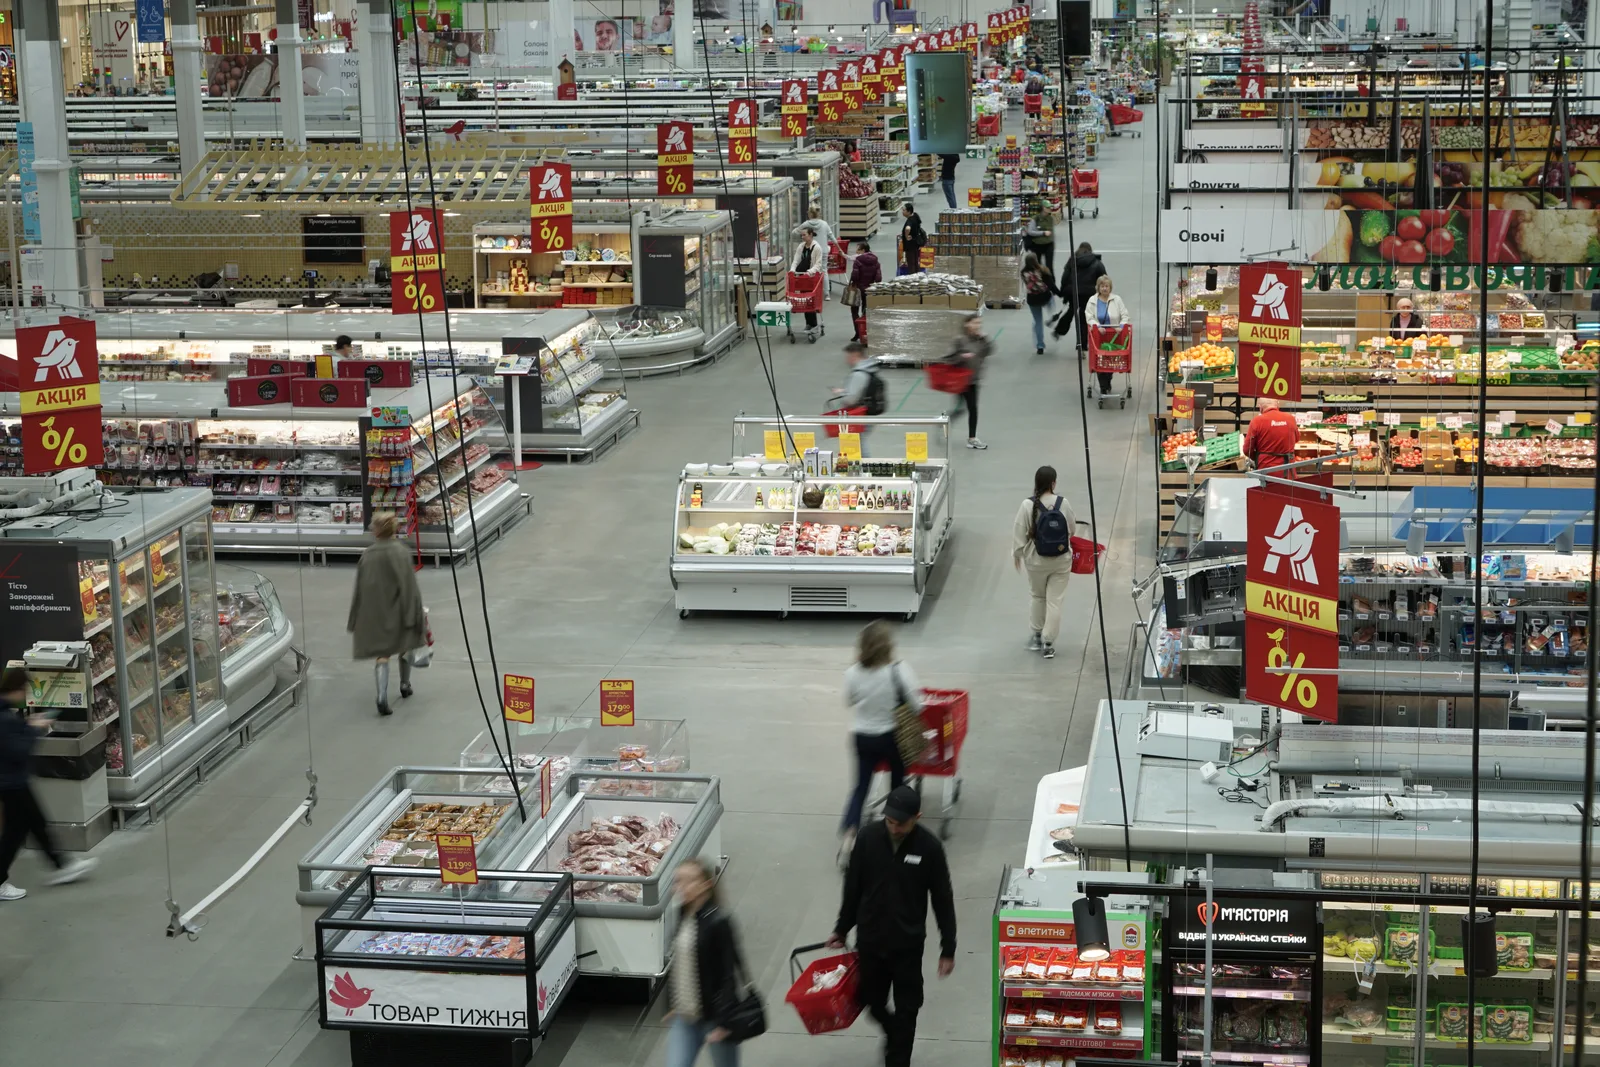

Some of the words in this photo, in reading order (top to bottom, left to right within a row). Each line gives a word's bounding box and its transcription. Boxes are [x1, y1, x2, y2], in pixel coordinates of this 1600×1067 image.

[664, 154, 688, 164] АКЦІЯ
[539, 203, 565, 214] АКЦІЯ
[1179, 229, 1225, 242] Овочі
[1250, 326, 1289, 342] АКЦІЯ
[36, 388, 86, 406] АКЦІЯ
[9, 593, 54, 601] Заморожені
[10, 604, 71, 612] напівфабрикати
[1263, 590, 1319, 621] АКЦІЯ
[1222, 908, 1288, 922] М'ЯСТОРІЯ
[1018, 927, 1065, 936] апетитна
[1218, 932, 1269, 942] УКРАЇНСЬКІ
[1271, 934, 1306, 943] СТЕЙКИ
[368, 1004, 439, 1022] ТОВАР
[446, 1008, 526, 1027] ТИЖНЯ
